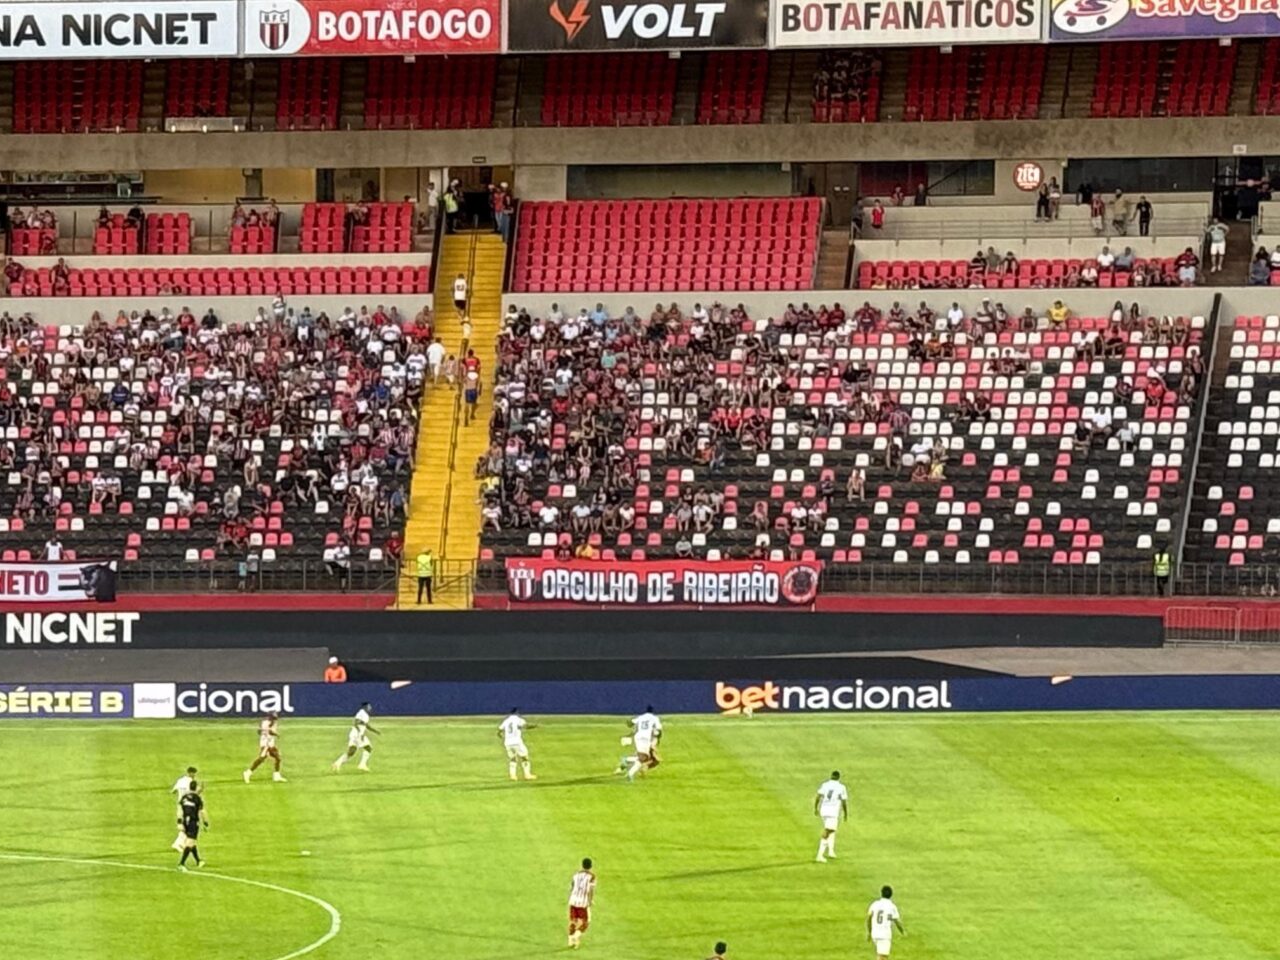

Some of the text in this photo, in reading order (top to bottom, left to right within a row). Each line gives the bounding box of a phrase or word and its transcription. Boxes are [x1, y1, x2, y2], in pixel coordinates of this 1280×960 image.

[318, 9, 491, 41] BOTAFOGO
[600, 3, 726, 39] VOLT
[1138, 0, 1280, 20] Savegna
[62, 12, 218, 46] NICNET
[542, 569, 638, 602] ORGULHO
[647, 571, 675, 603] DE
[683, 564, 779, 603] RIBEIRÃO
[6, 612, 140, 644] NICNET
[100, 691, 124, 713] B
[177, 683, 294, 712] cional
[715, 679, 952, 710] betnacional
